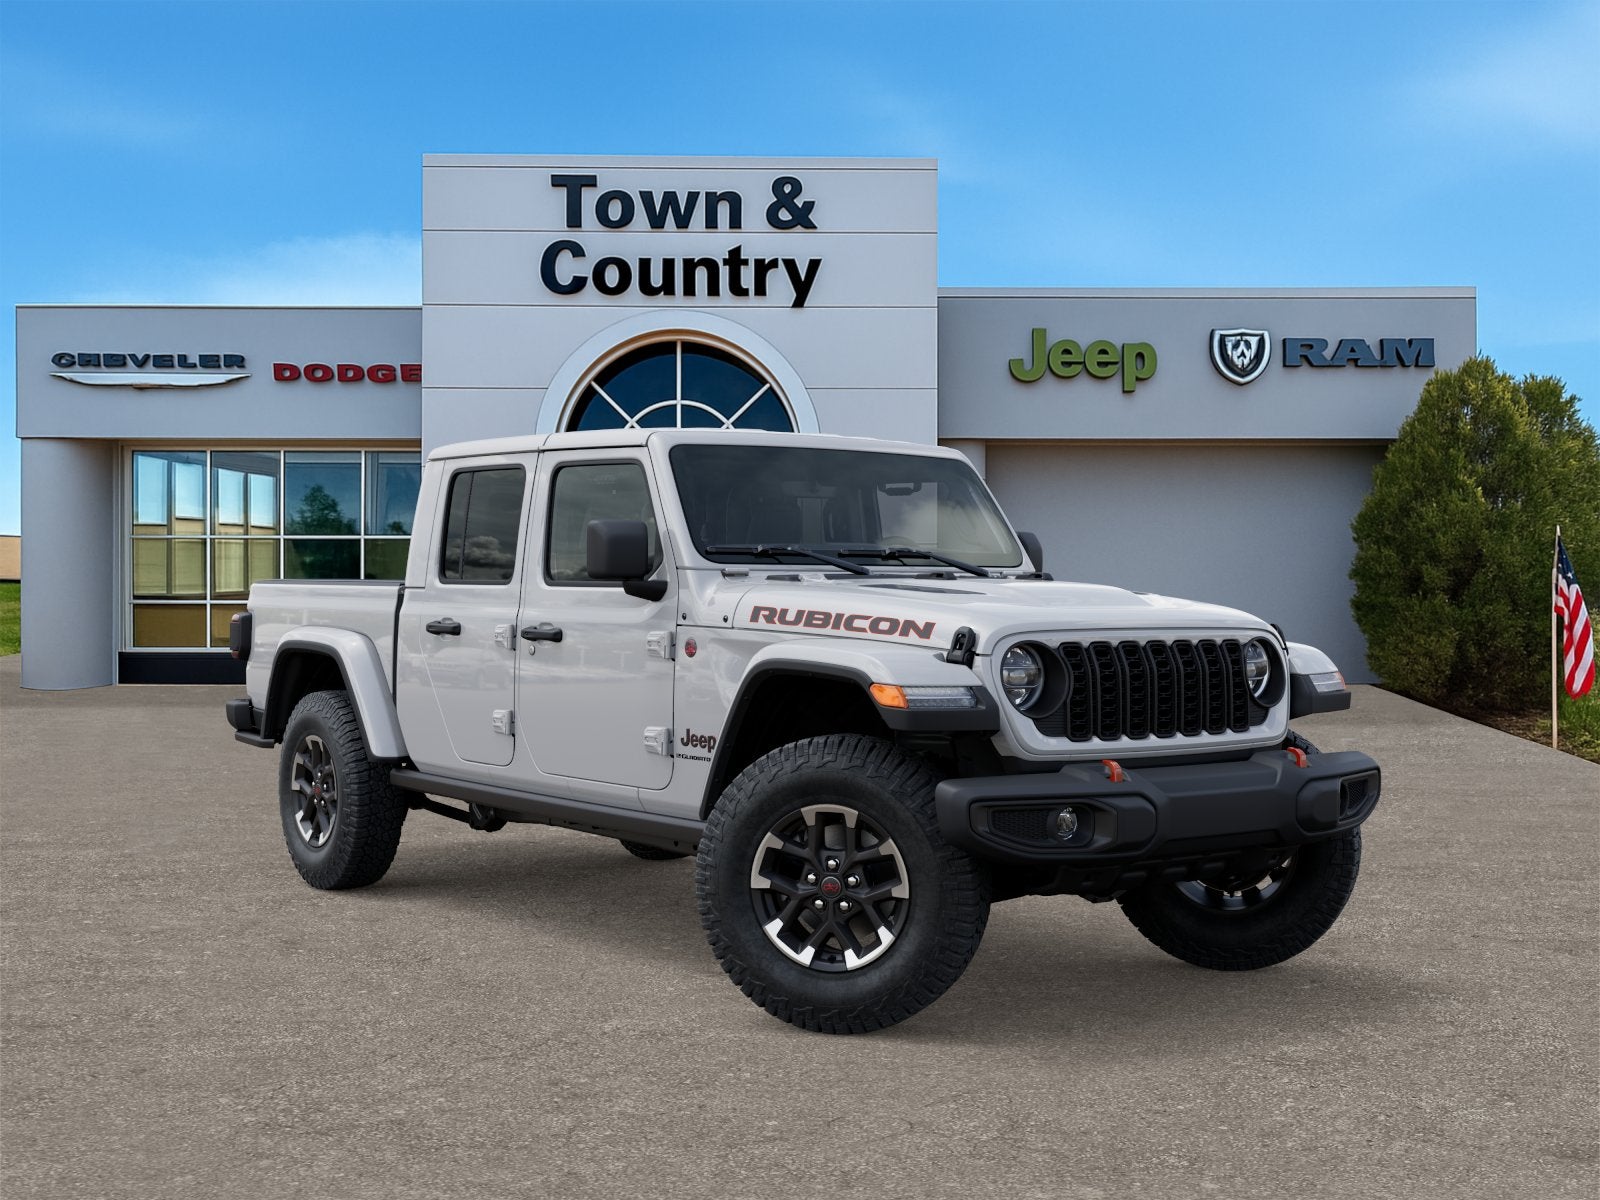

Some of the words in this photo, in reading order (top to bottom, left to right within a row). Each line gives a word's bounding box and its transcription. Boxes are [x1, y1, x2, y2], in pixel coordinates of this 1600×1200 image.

[550, 174, 742, 229] Town
[765, 176, 818, 230] &
[540, 239, 822, 308] Country
[1008, 327, 1158, 393] Jeep
[1282, 337, 1436, 368] RAM
[273, 362, 422, 383] DODGE
[750, 605, 936, 640] RUBICON
[680, 728, 717, 754] Jeep
